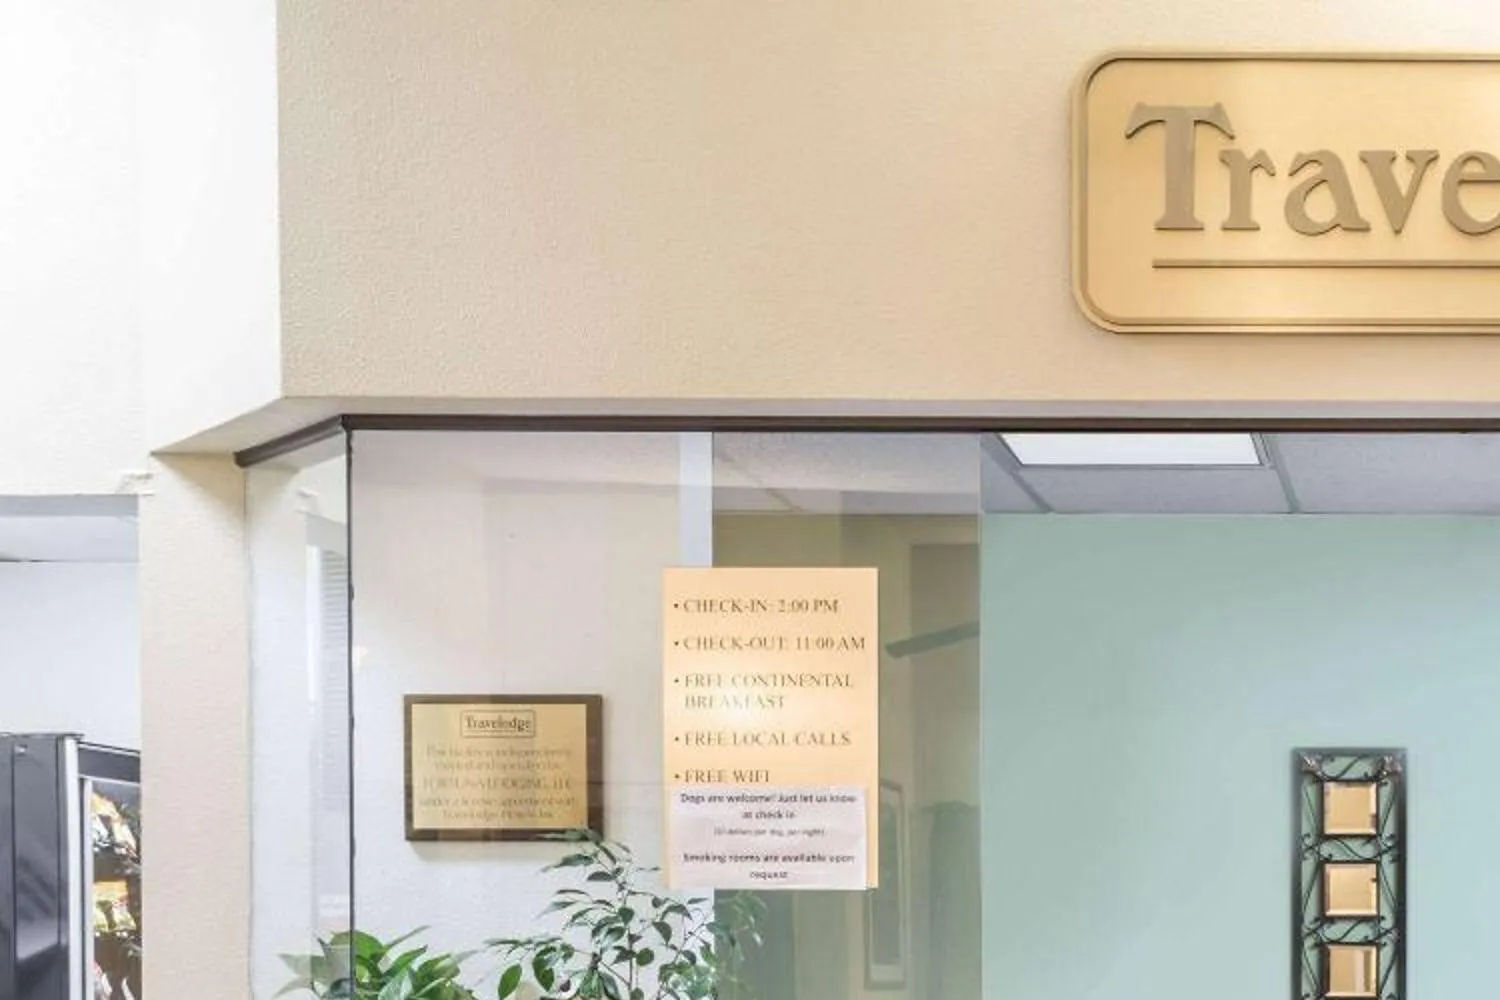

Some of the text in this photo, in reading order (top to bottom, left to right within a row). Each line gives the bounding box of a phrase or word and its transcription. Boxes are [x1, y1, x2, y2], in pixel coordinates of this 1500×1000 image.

[683, 598, 839, 614] CHECK-IN: 2:00 PM
[683, 636, 866, 651] CHECK-OUT: 11:00 AM
[684, 673, 854, 688] FREE CONTINENTAL
[684, 695, 785, 710] BREAKFAST
[465, 714, 531, 733] Travelodge
[684, 731, 851, 746] FREE LOCAL CALLS
[684, 769, 770, 783] FREE WIFI
[680, 793, 705, 805] Dogs
[707, 795, 725, 804] are
[778, 793, 798, 804] Just
[799, 793, 813, 803] let
[815, 795, 827, 804] us
[829, 793, 857, 804] know
[742, 811, 753, 819] at
[755, 810, 782, 820] check
[683, 853, 855, 865] Smoking rooms are available upon
[749, 871, 788, 881] request
